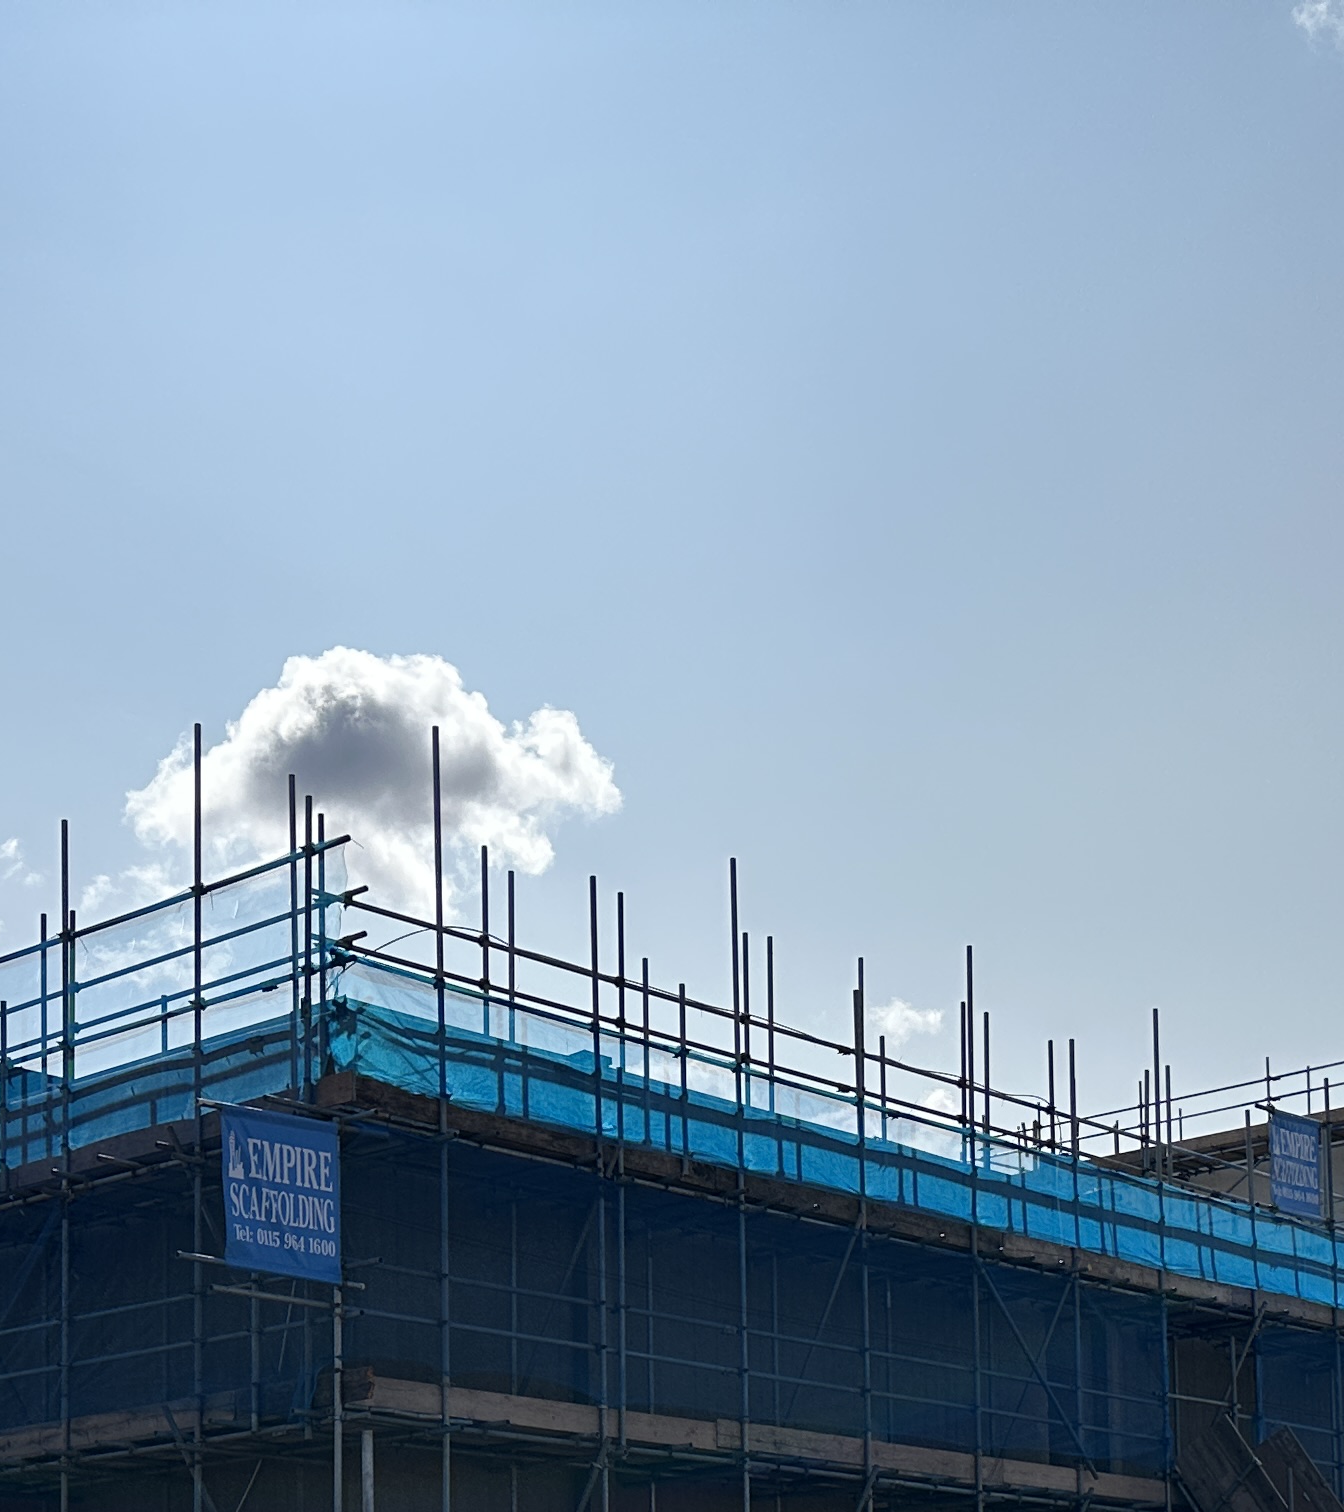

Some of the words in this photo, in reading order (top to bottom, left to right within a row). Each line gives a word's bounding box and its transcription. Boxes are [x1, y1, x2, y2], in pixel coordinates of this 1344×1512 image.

[247, 1137, 333, 1192] EMPIRE
[229, 1182, 335, 1234] SCAFFOLDING
[233, 1223, 254, 1243] Tel:
[256, 1228, 281, 1248] 0115
[283, 1234, 305, 1252] 964
[308, 1237, 336, 1257] 1600
